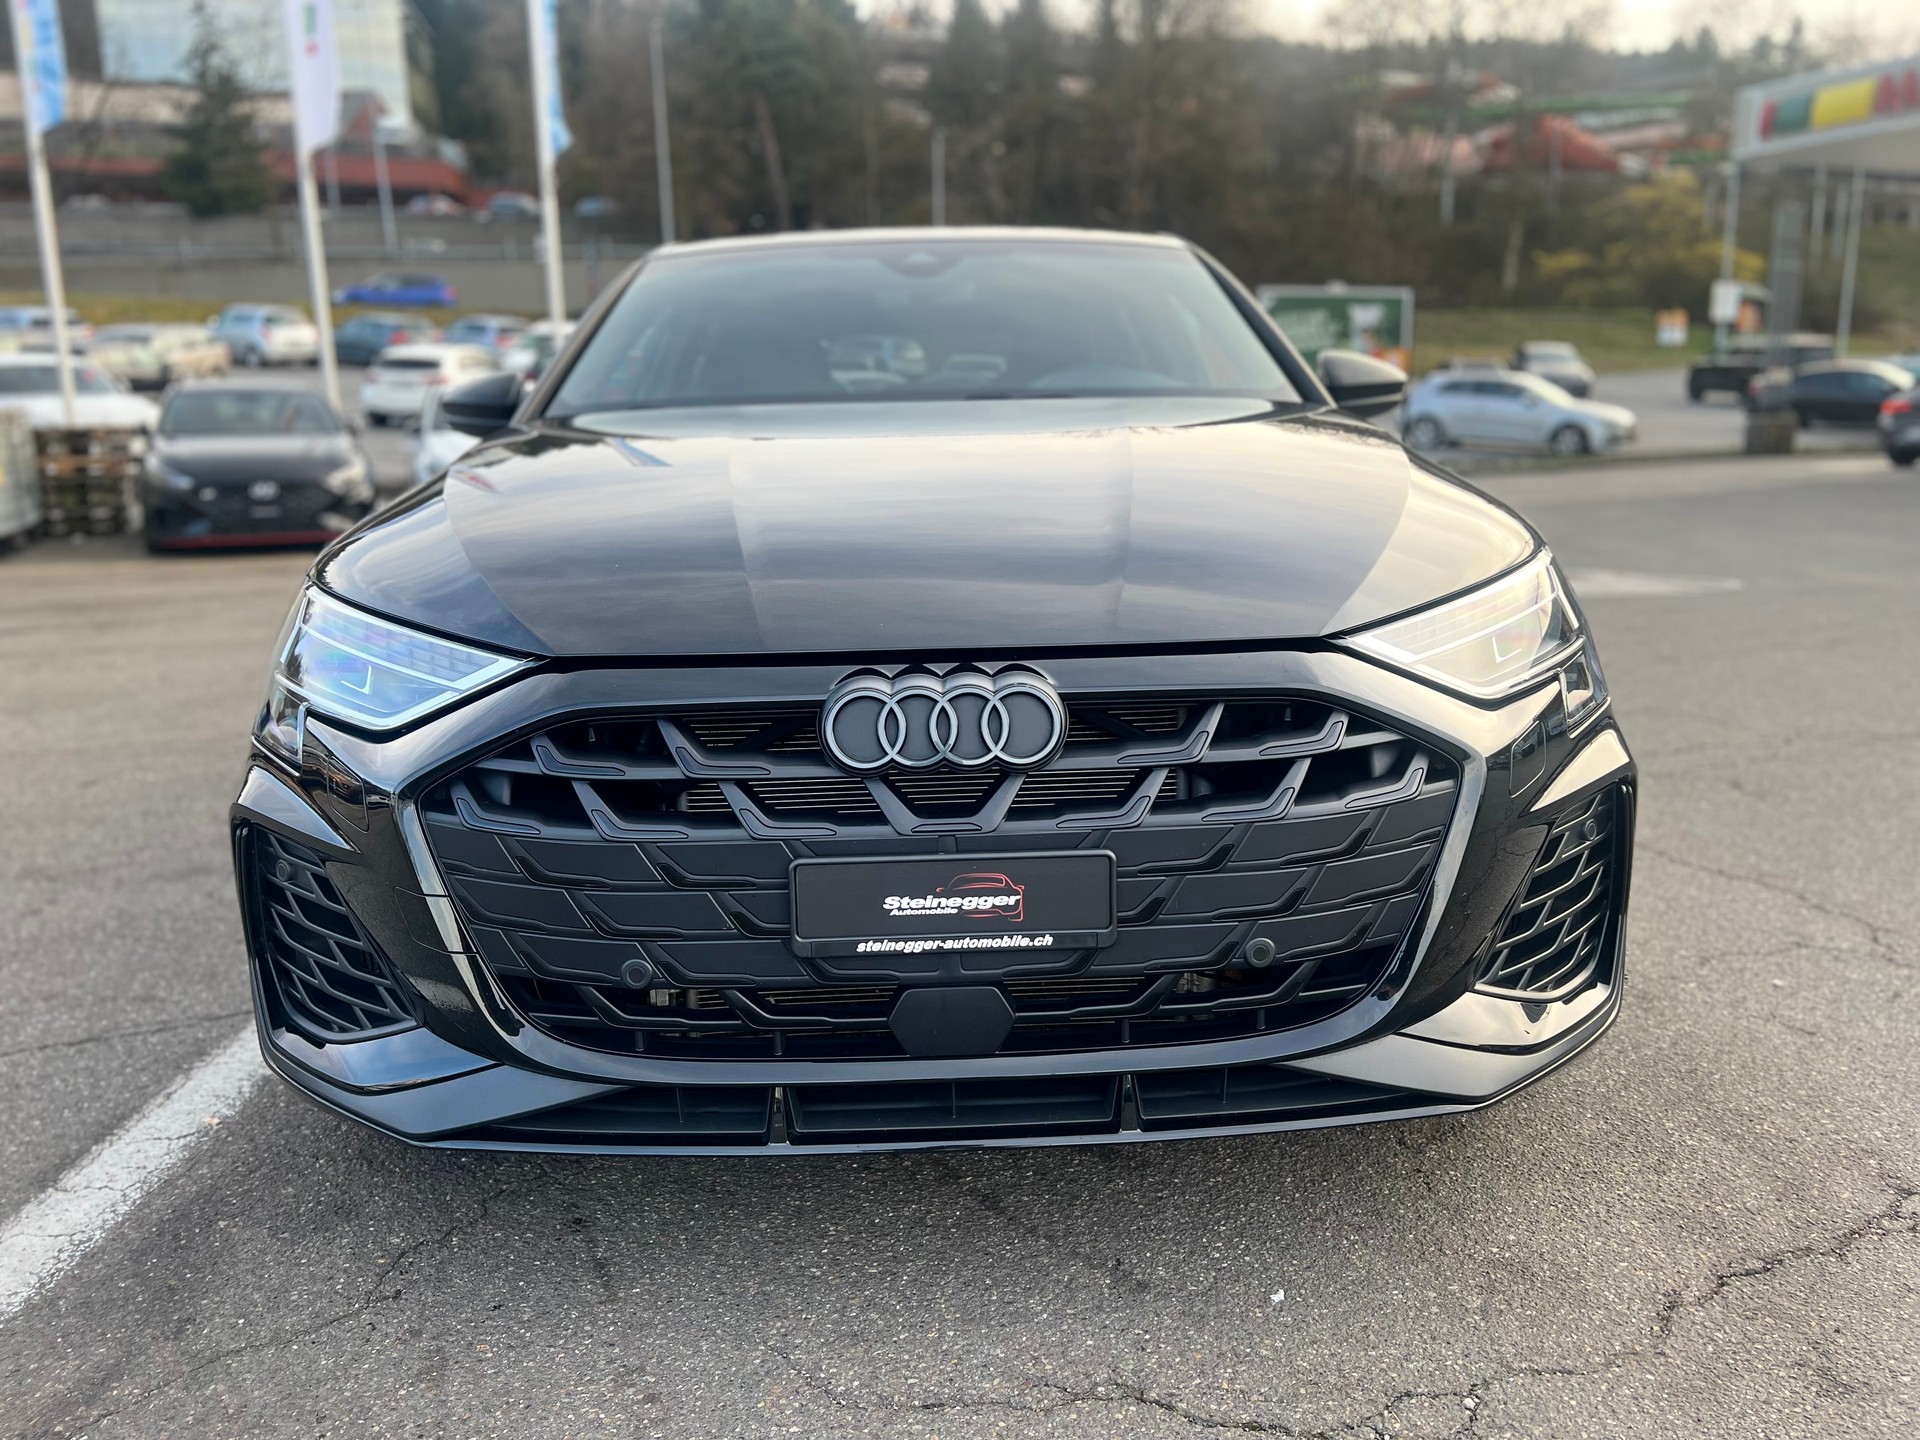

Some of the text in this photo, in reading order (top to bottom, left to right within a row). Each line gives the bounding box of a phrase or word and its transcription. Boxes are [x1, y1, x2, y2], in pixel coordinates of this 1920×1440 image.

[883, 895, 1022, 910] Steinegger
[889, 907, 959, 916] Automobile
[856, 934, 1054, 953] steinegger-automobile.ch
